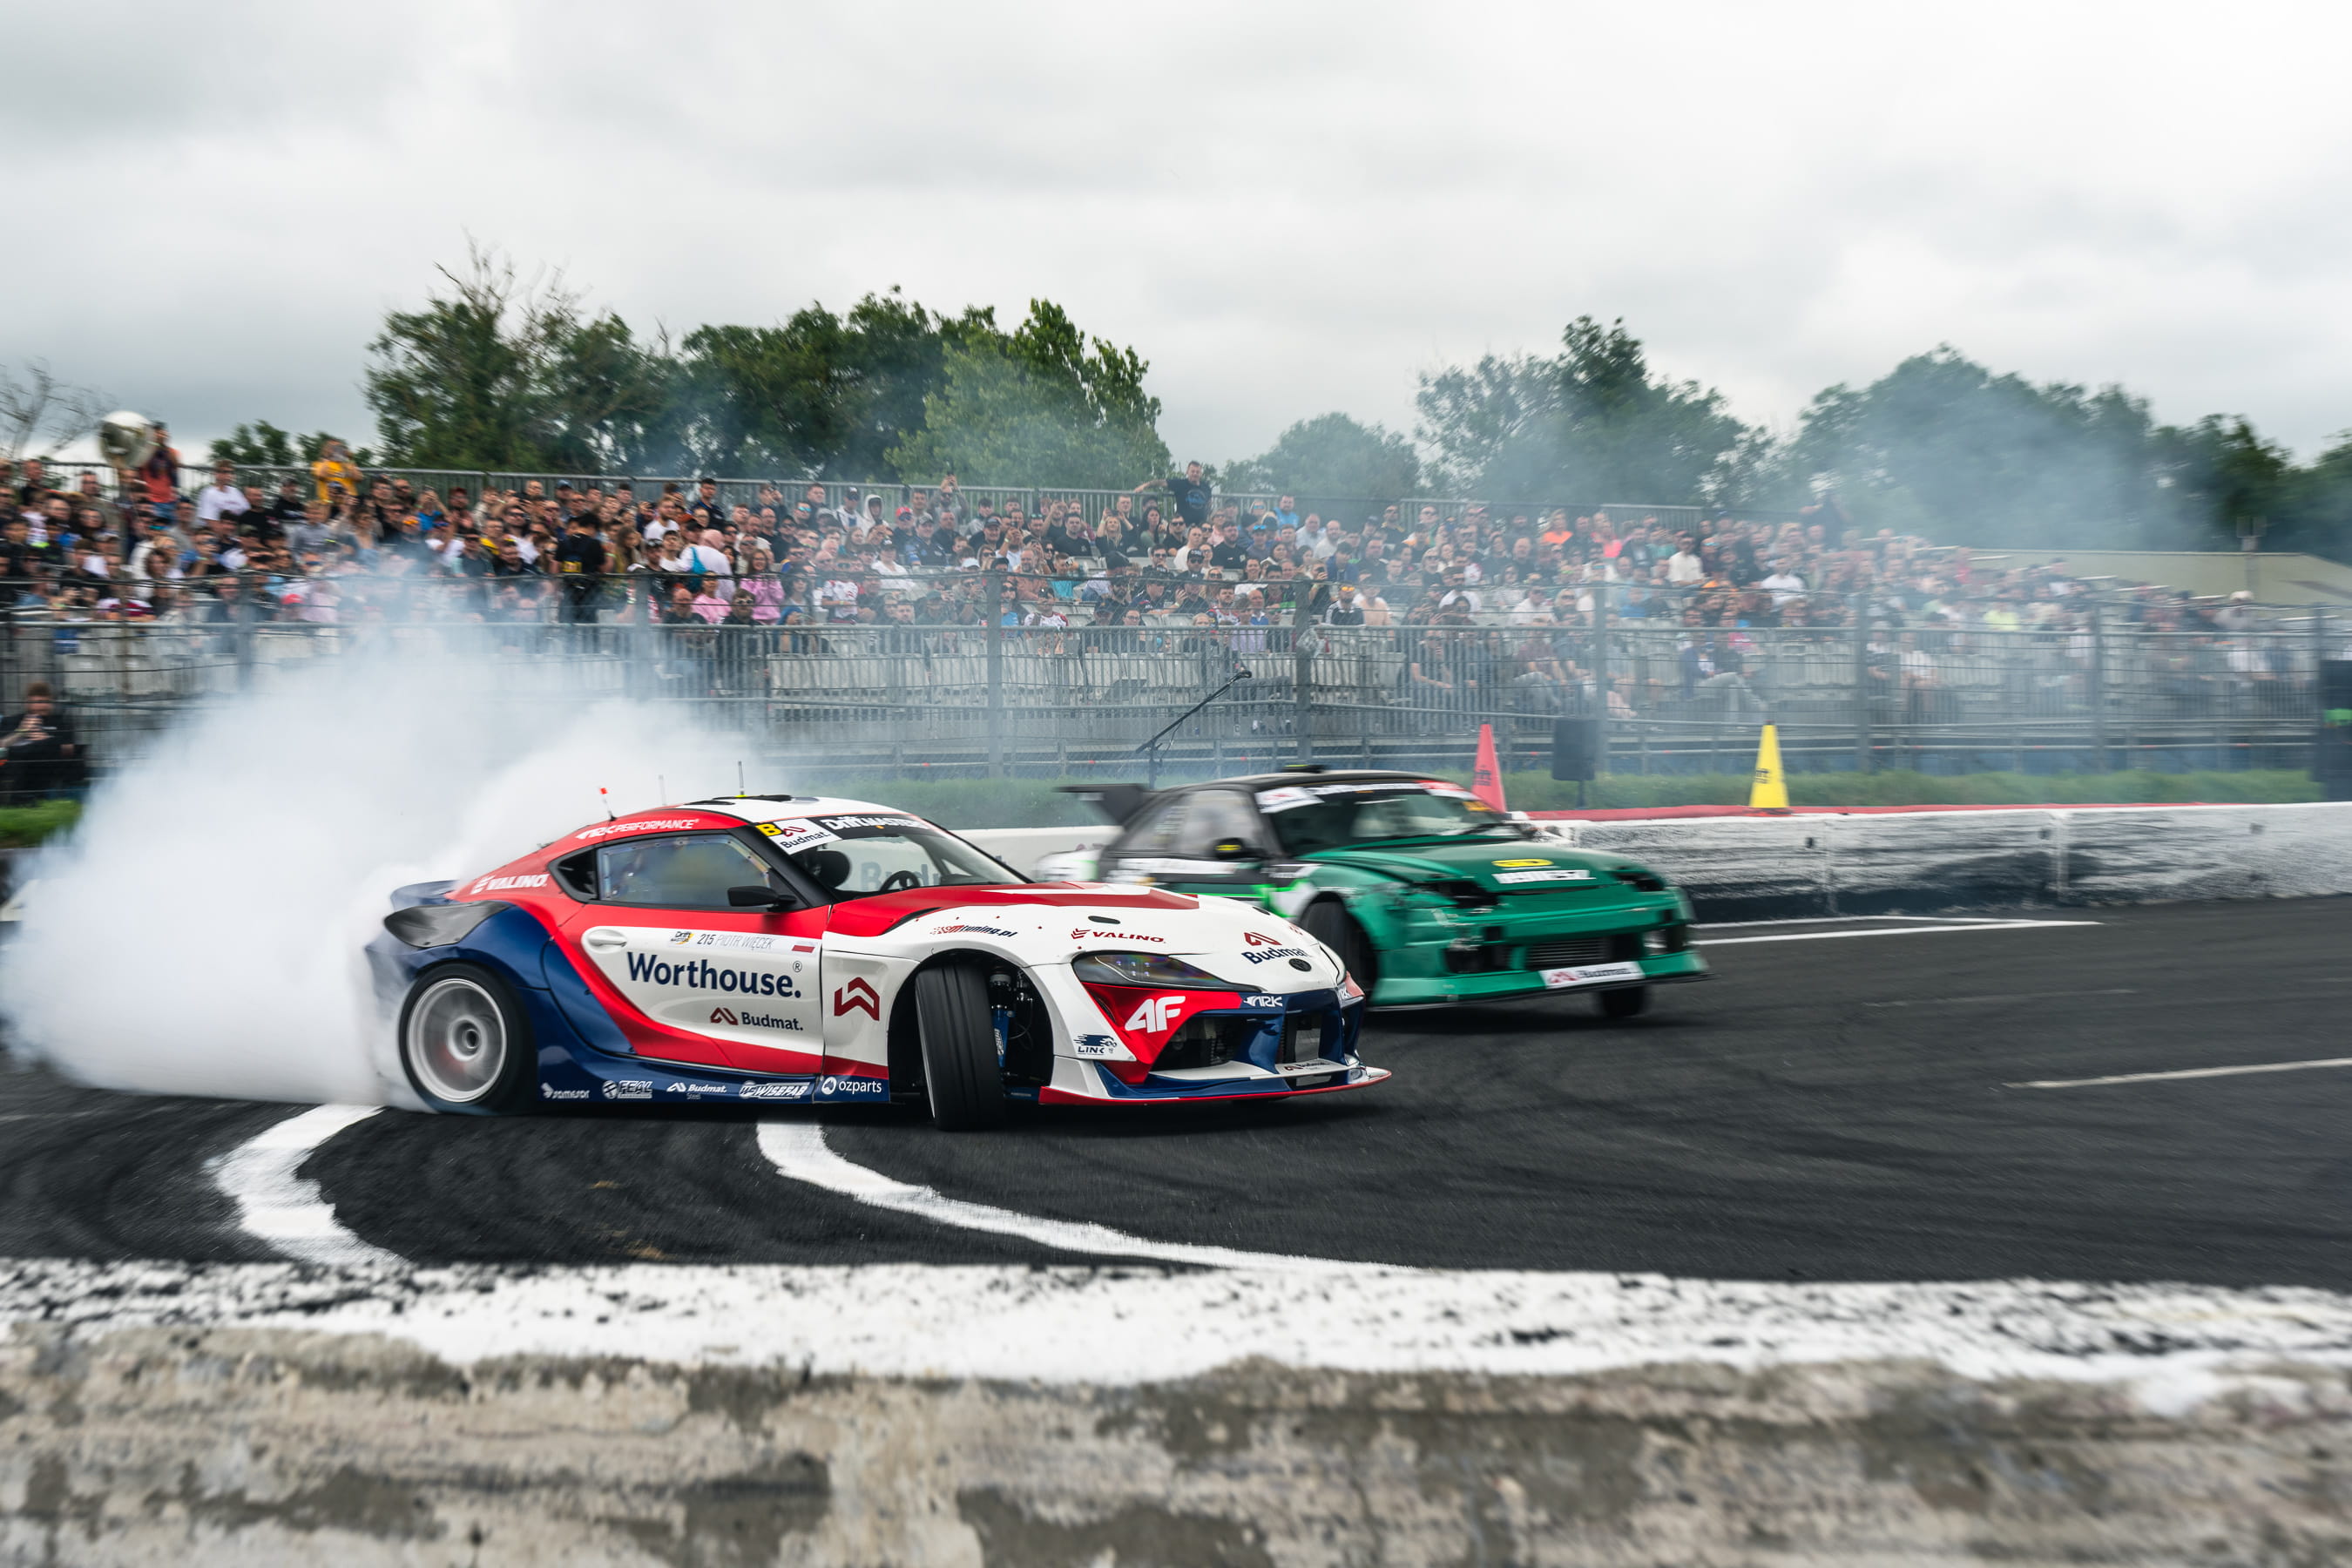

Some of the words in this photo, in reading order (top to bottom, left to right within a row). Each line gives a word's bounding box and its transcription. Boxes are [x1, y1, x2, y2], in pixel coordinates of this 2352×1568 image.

[780, 831, 831, 848] Budmat.
[485, 874, 551, 890] VALINO
[697, 934, 716, 945] 215
[715, 935, 742, 947] PIOTR
[1092, 931, 1164, 943] VALINO
[627, 951, 801, 998] Worthouse.
[1244, 996, 1283, 1007] ARK
[740, 1011, 804, 1031] Budmat.
[619, 1080, 652, 1094] FEAL
[688, 1084, 727, 1093] Budmat.
[754, 1085, 808, 1097] WISEFAB
[838, 1081, 882, 1094] ozparts
